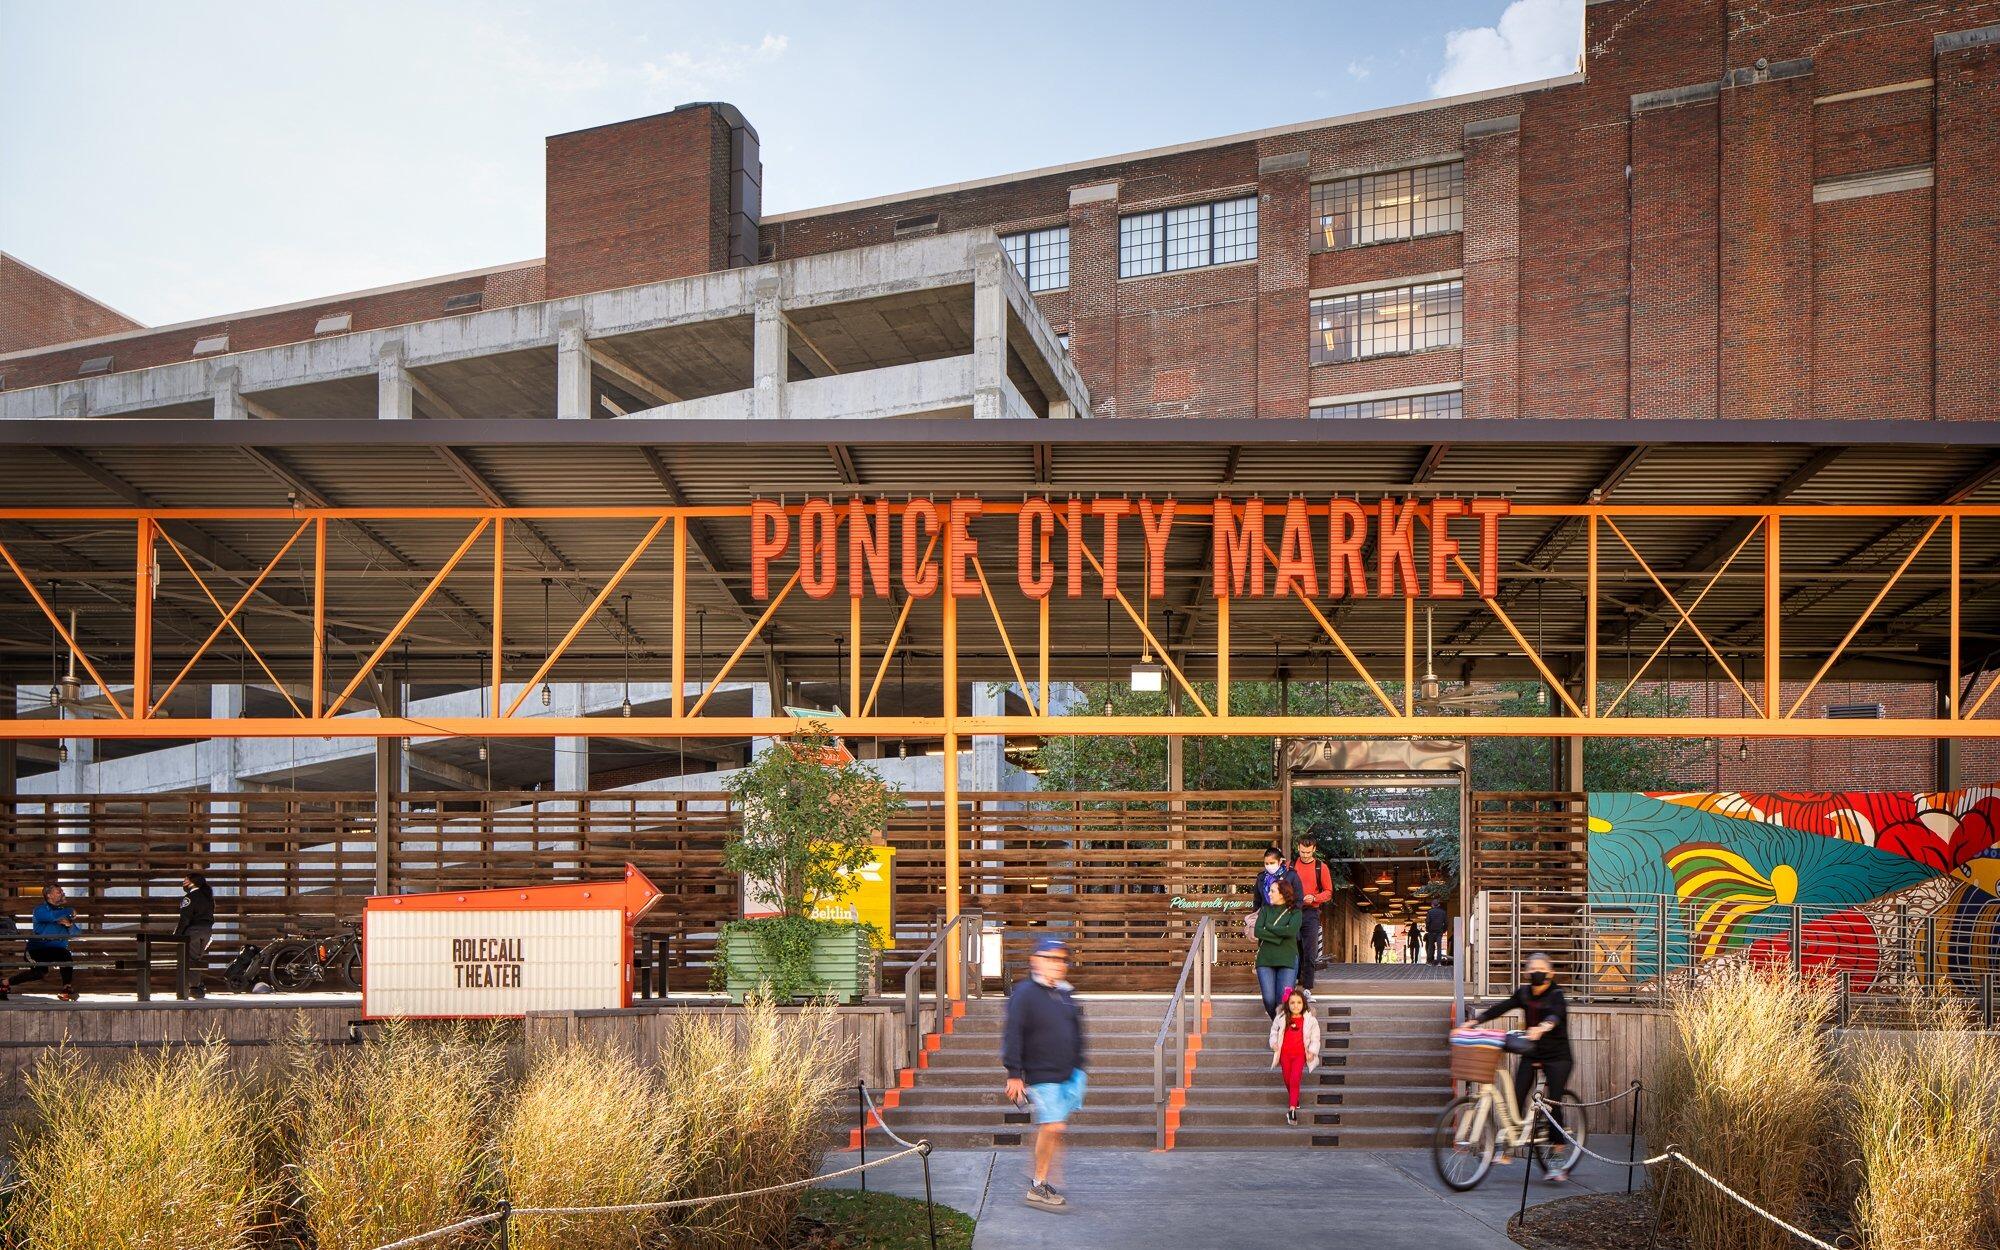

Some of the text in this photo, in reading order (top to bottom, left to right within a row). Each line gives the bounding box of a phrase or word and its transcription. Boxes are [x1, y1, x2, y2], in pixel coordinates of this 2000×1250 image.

[751, 496, 1511, 600] PONCE CITY MARKET
[811, 904, 857, 920] Beltlin
[1169, 896, 1200, 909] Please
[1200, 896, 1223, 909] walk
[1223, 900, 1244, 912] your
[452, 938, 525, 962] ROLECALL
[454, 963, 521, 988] THEATER
